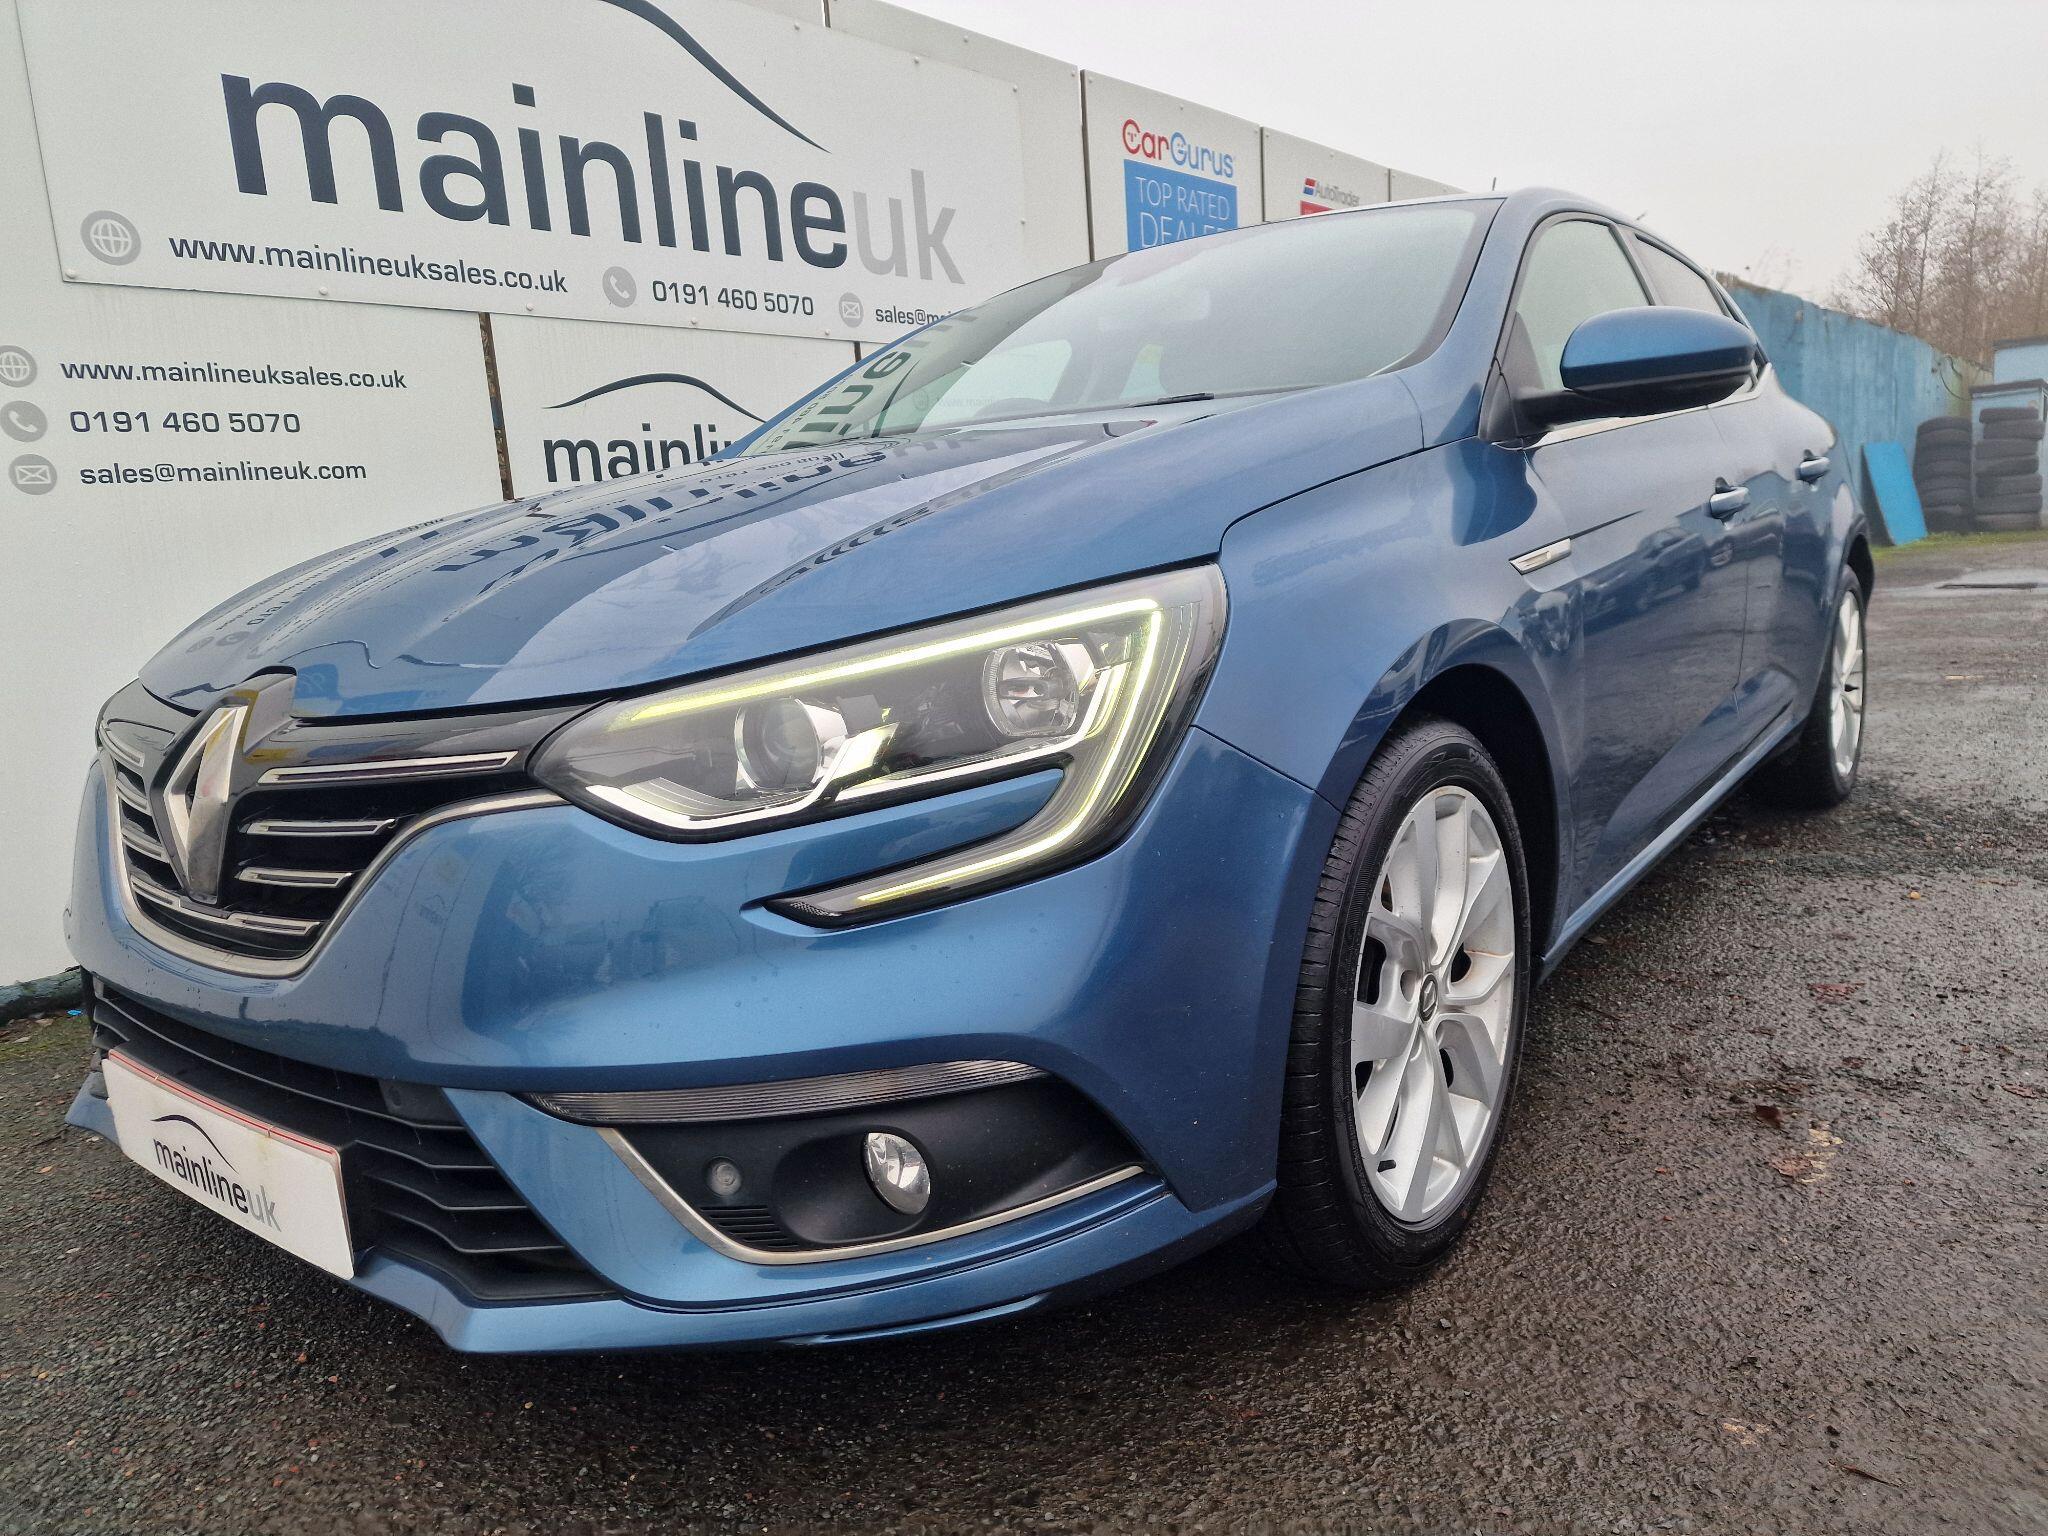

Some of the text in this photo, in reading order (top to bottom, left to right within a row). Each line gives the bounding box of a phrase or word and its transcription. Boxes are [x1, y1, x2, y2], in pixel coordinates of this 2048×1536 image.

[1122, 118, 1234, 178] CarGurus
[221, 74, 965, 284] mainlineuk
[1135, 176, 1230, 220] TOP RATED
[169, 237, 568, 293] www.mainlineuksales.co.uk
[652, 280, 814, 316] 0191 460 5070
[60, 362, 408, 389] www.mainlineuksales.co.uk
[69, 410, 301, 434] 0191 460 5070
[80, 460, 367, 485] sales@mainlineuk.com
[153, 1138, 282, 1233] mainlineuk
